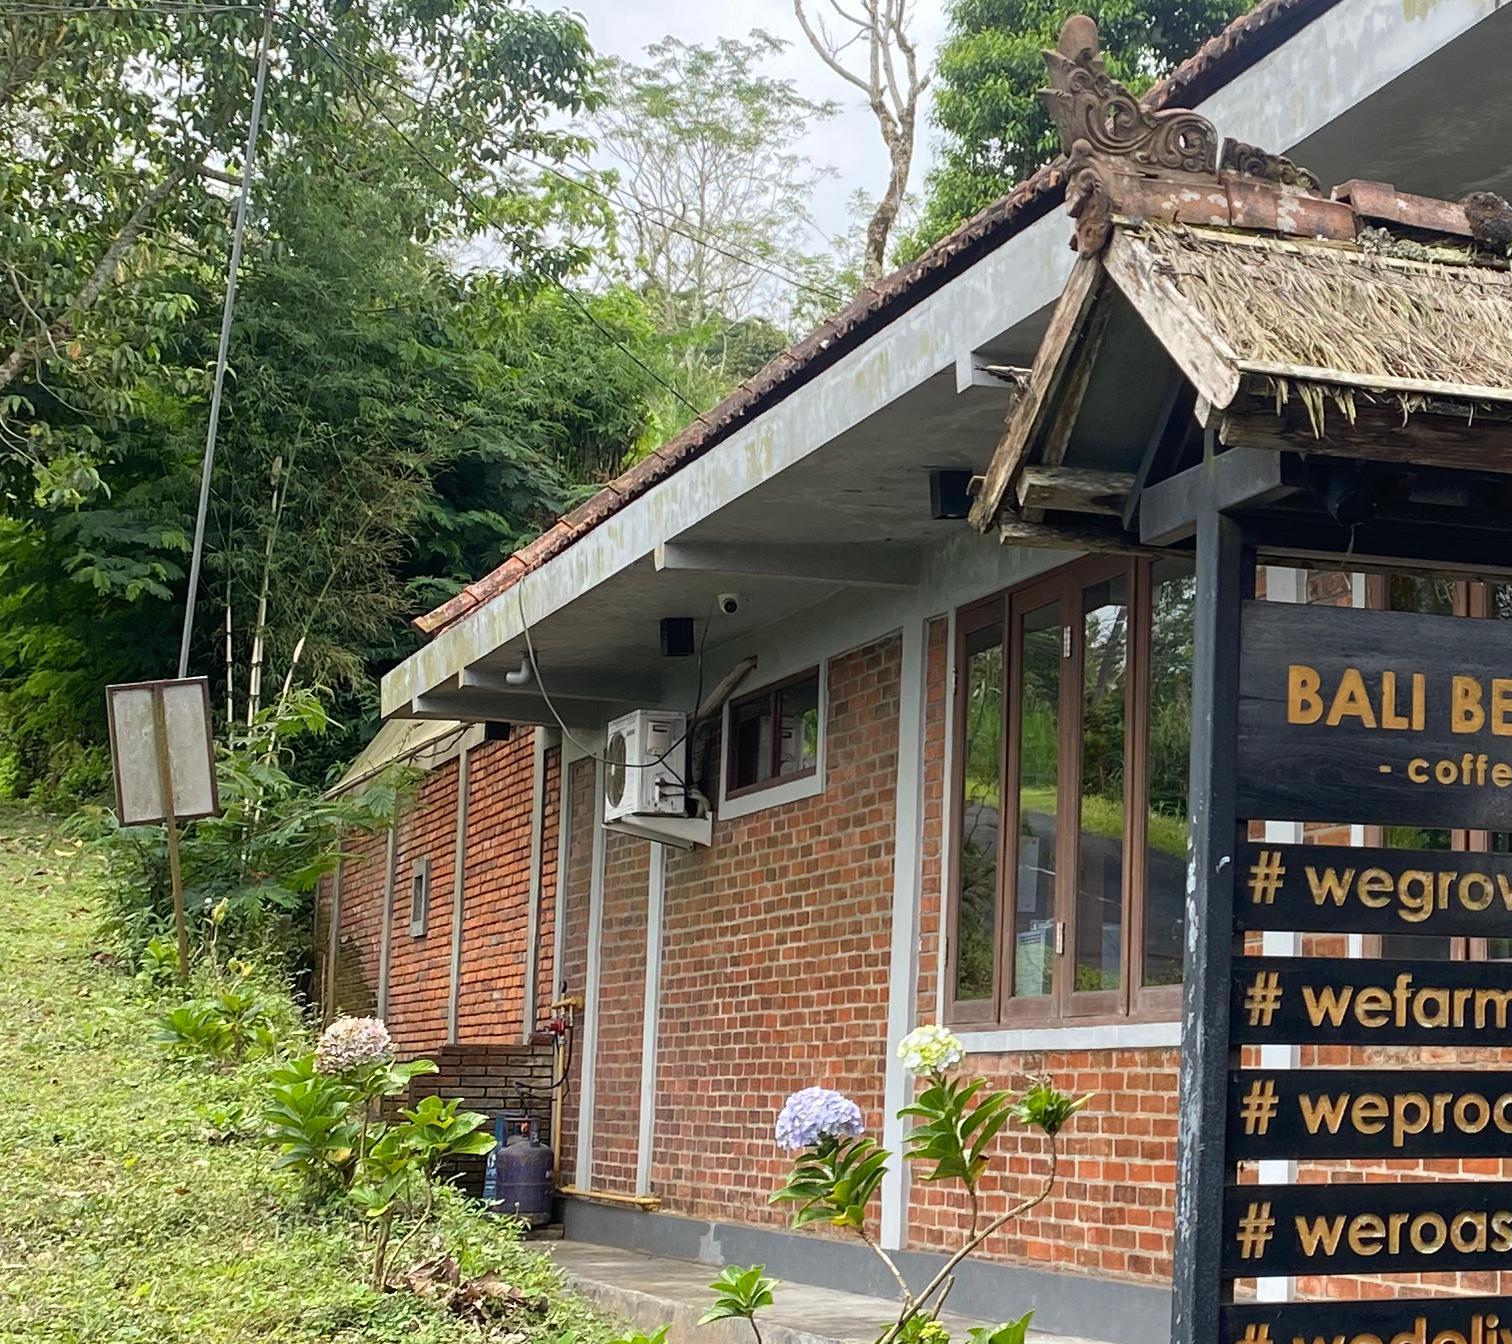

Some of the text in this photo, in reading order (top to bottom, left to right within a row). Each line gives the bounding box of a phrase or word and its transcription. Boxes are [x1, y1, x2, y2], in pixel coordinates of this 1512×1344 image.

[1286, 664, 1426, 732] BALI
[1246, 850, 1287, 906] #
[1243, 971, 1284, 1027] #
[1239, 1079, 1280, 1136] #
[1237, 1202, 1276, 1260] #
